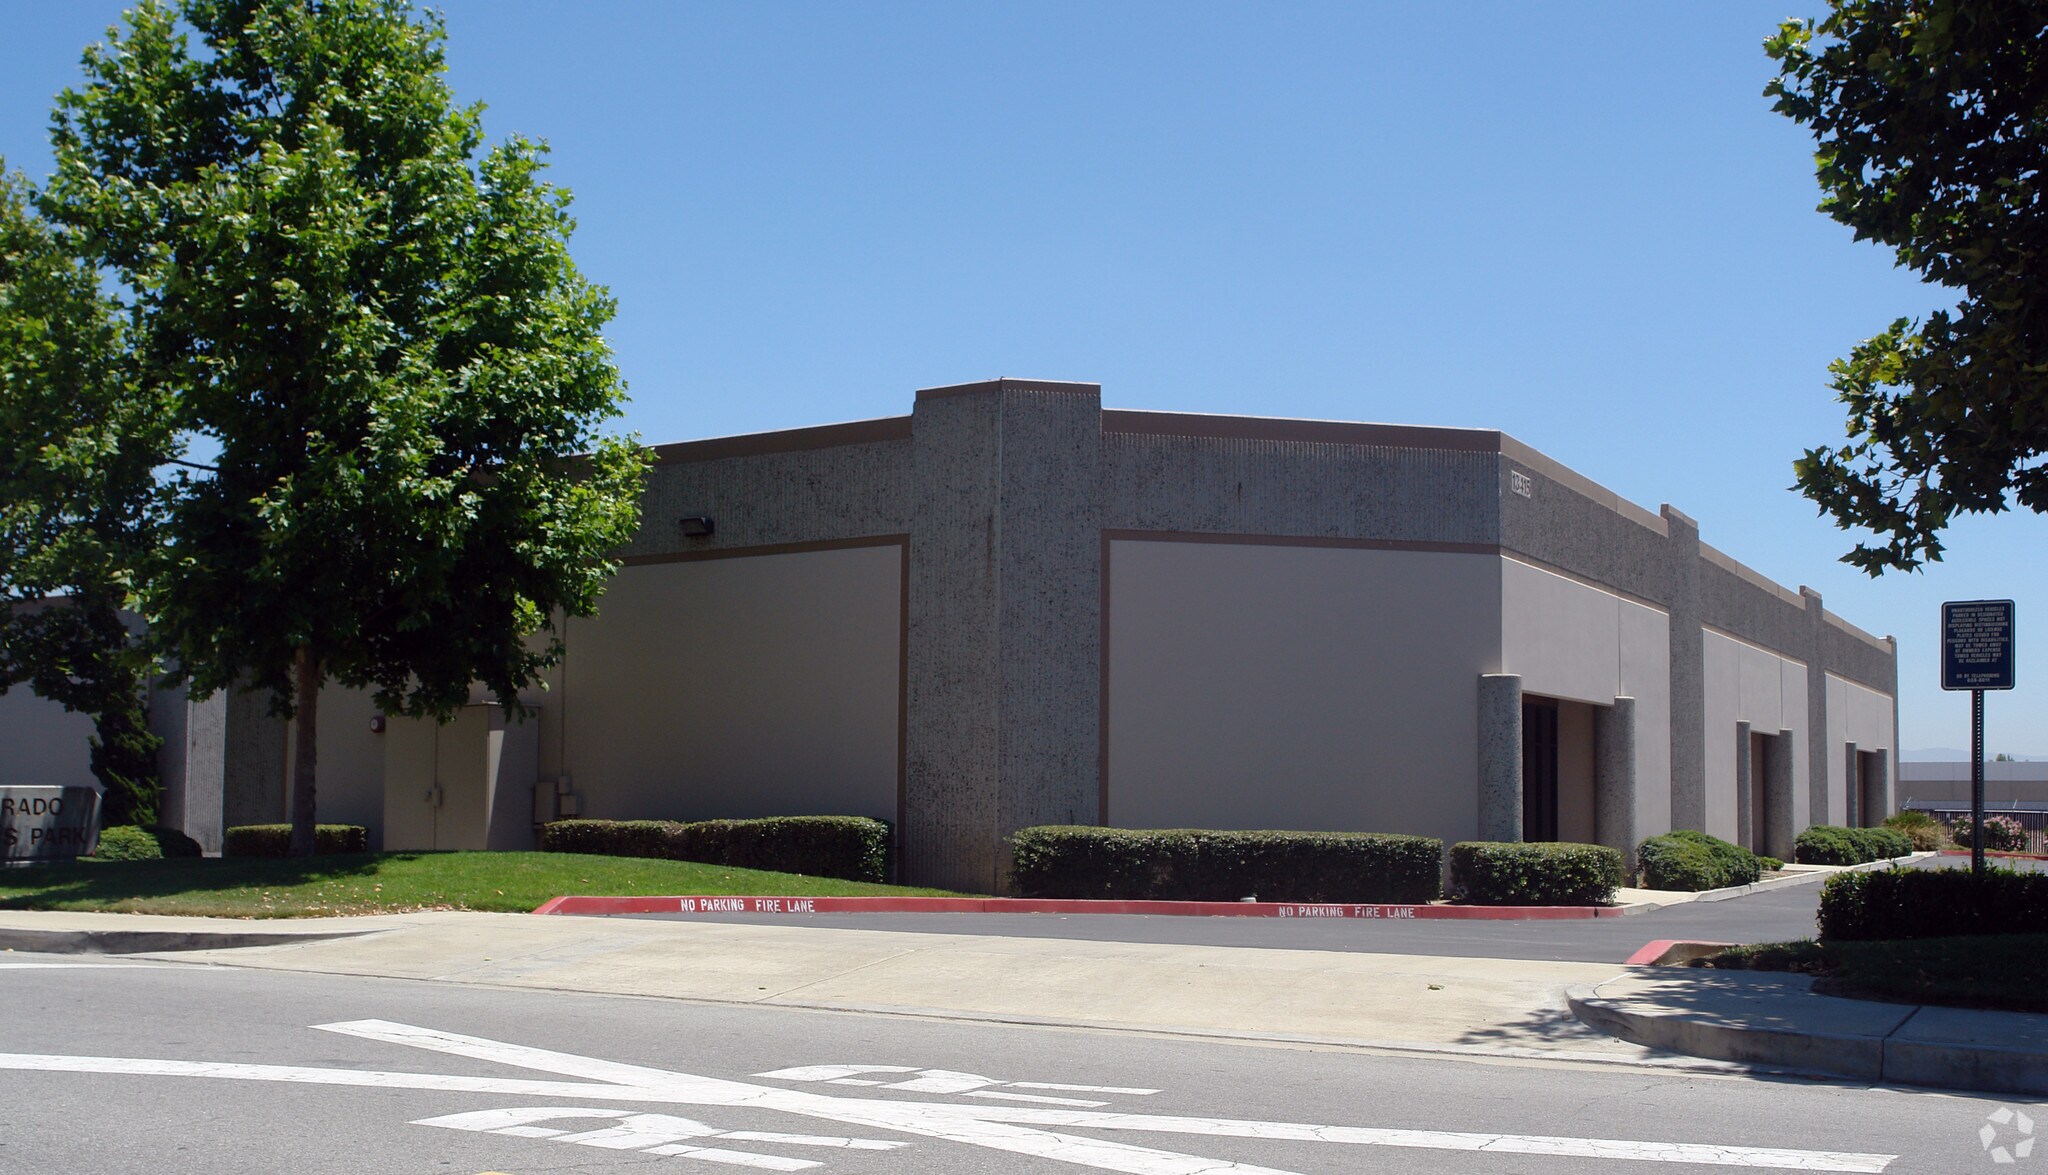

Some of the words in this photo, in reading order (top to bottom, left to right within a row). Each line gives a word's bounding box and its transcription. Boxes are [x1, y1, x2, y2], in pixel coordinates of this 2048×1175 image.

[1512, 473, 1531, 496] 13415
[1, 798, 64, 816] RADO
[31, 827, 87, 846] PARK
[680, 899, 695, 912] NO
[700, 898, 744, 911] PARKING
[756, 900, 781, 912] FIRE
[787, 900, 815, 912] LANE
[1278, 906, 1293, 917] NO
[1298, 906, 1344, 918] PARKING
[1354, 907, 1380, 918] FIRE
[1387, 908, 1415, 919] LANE
